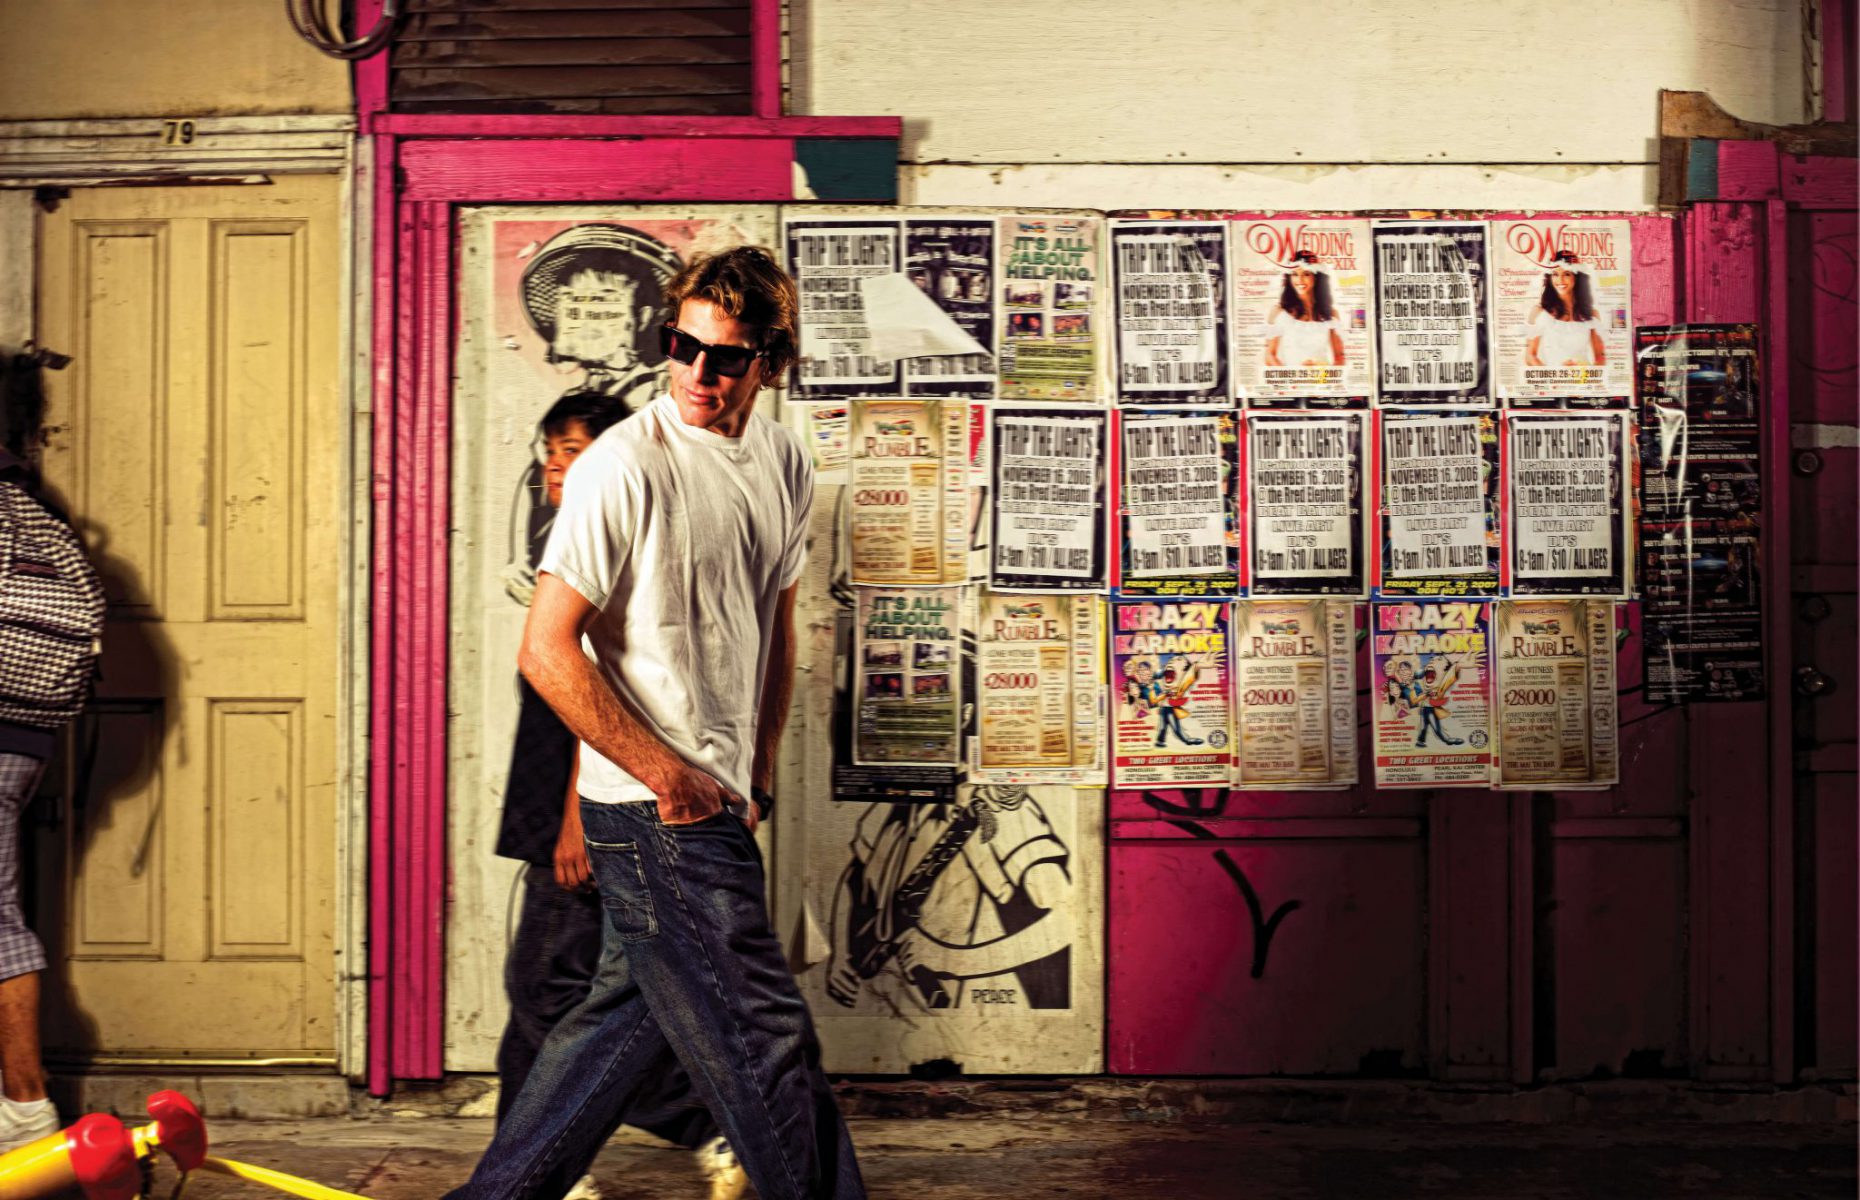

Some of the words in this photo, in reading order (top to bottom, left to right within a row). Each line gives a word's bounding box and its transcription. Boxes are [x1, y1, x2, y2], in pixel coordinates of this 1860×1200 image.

[165, 121, 194, 144] 79
[1014, 236, 1045, 251] IT'S
[1054, 236, 1088, 251] ALL
[1246, 223, 1354, 268] WEDDING
[1506, 223, 1614, 268] WEDDING
[1010, 251, 1083, 266] ABOUT
[1334, 257, 1357, 270] XIX
[1382, 242, 1407, 273] TRIP
[1409, 242, 1430, 273] THE
[1594, 257, 1618, 270] XIX
[1124, 284, 1171, 299] NOVEMBER
[1384, 284, 1431, 299] NOVEMBER
[1448, 284, 1470, 299] 2006
[1394, 301, 1408, 317] the
[1265, 370, 1297, 378] OCTOBER
[1324, 370, 1343, 378] 2007
[1454, 361, 1474, 383] AGES
[1525, 370, 1558, 378] OCTOBER
[1585, 370, 1603, 378] 2007
[865, 437, 930, 458] RUMBLE
[1127, 427, 1152, 458] TRIP
[1155, 426, 1176, 457] THE
[1179, 424, 1217, 456] LIGHTS
[1256, 428, 1281, 459] TRIP
[1284, 428, 1304, 459] THE
[1307, 427, 1344, 459] LIGHTS
[1388, 427, 1413, 458] TRIP
[1415, 426, 1437, 457] THE
[1439, 424, 1477, 456] LIGHTS
[1517, 428, 1541, 459] TRIP
[1544, 428, 1565, 459] THE
[1567, 427, 1604, 459] LIGHTS
[1131, 468, 1178, 485] NOVEMBER
[1194, 466, 1218, 482] 2006
[1258, 470, 1305, 486] NOVEMBER
[1322, 470, 1345, 485] 2006
[1391, 468, 1438, 485] NOVEMBER
[1454, 466, 1478, 482] 2006
[1518, 470, 1566, 486] NOVEMBER
[1582, 470, 1605, 485] 2006
[1268, 487, 1282, 503] the
[1307, 486, 1345, 504] Elephant
[1401, 486, 1416, 502] the
[1440, 483, 1479, 501] Elephant
[1528, 487, 1543, 503] the
[1567, 486, 1605, 504] Elephant
[1391, 503, 1428, 516] BEAT
[1430, 501, 1481, 514] BATTLE
[1518, 505, 1555, 517] BEAT
[1557, 504, 1607, 516] BATTLE
[1406, 518, 1437, 531] LIVE
[1440, 516, 1468, 529] ART
[1532, 520, 1564, 532] LIVE
[1566, 519, 1595, 532] ART
[1313, 548, 1327, 570] ALL
[1328, 548, 1347, 570] AGES
[1449, 545, 1462, 568] ALL
[1463, 544, 1483, 567] AGES
[1551, 548, 1566, 571] $10
[1573, 548, 1587, 570] ALL
[1588, 548, 1608, 570] AGES
[1124, 580, 1161, 588] FRIDAY
[1385, 580, 1422, 588] FRIDAY
[1471, 580, 1497, 588] 2007
[1416, 587, 1439, 595] DON
[874, 597, 906, 611] IT'S
[913, 597, 949, 611] ALL
[869, 611, 943, 626] ABOUT
[1118, 603, 1221, 631] KRAZY
[1378, 603, 1481, 631] KRAZY
[994, 619, 1059, 641] RUMBLE
[1115, 632, 1225, 654] KARAOKE
[1251, 635, 1315, 657] RUMBLE
[1375, 632, 1485, 654] KARAOKE
[1511, 635, 1575, 657] RUMBLE
